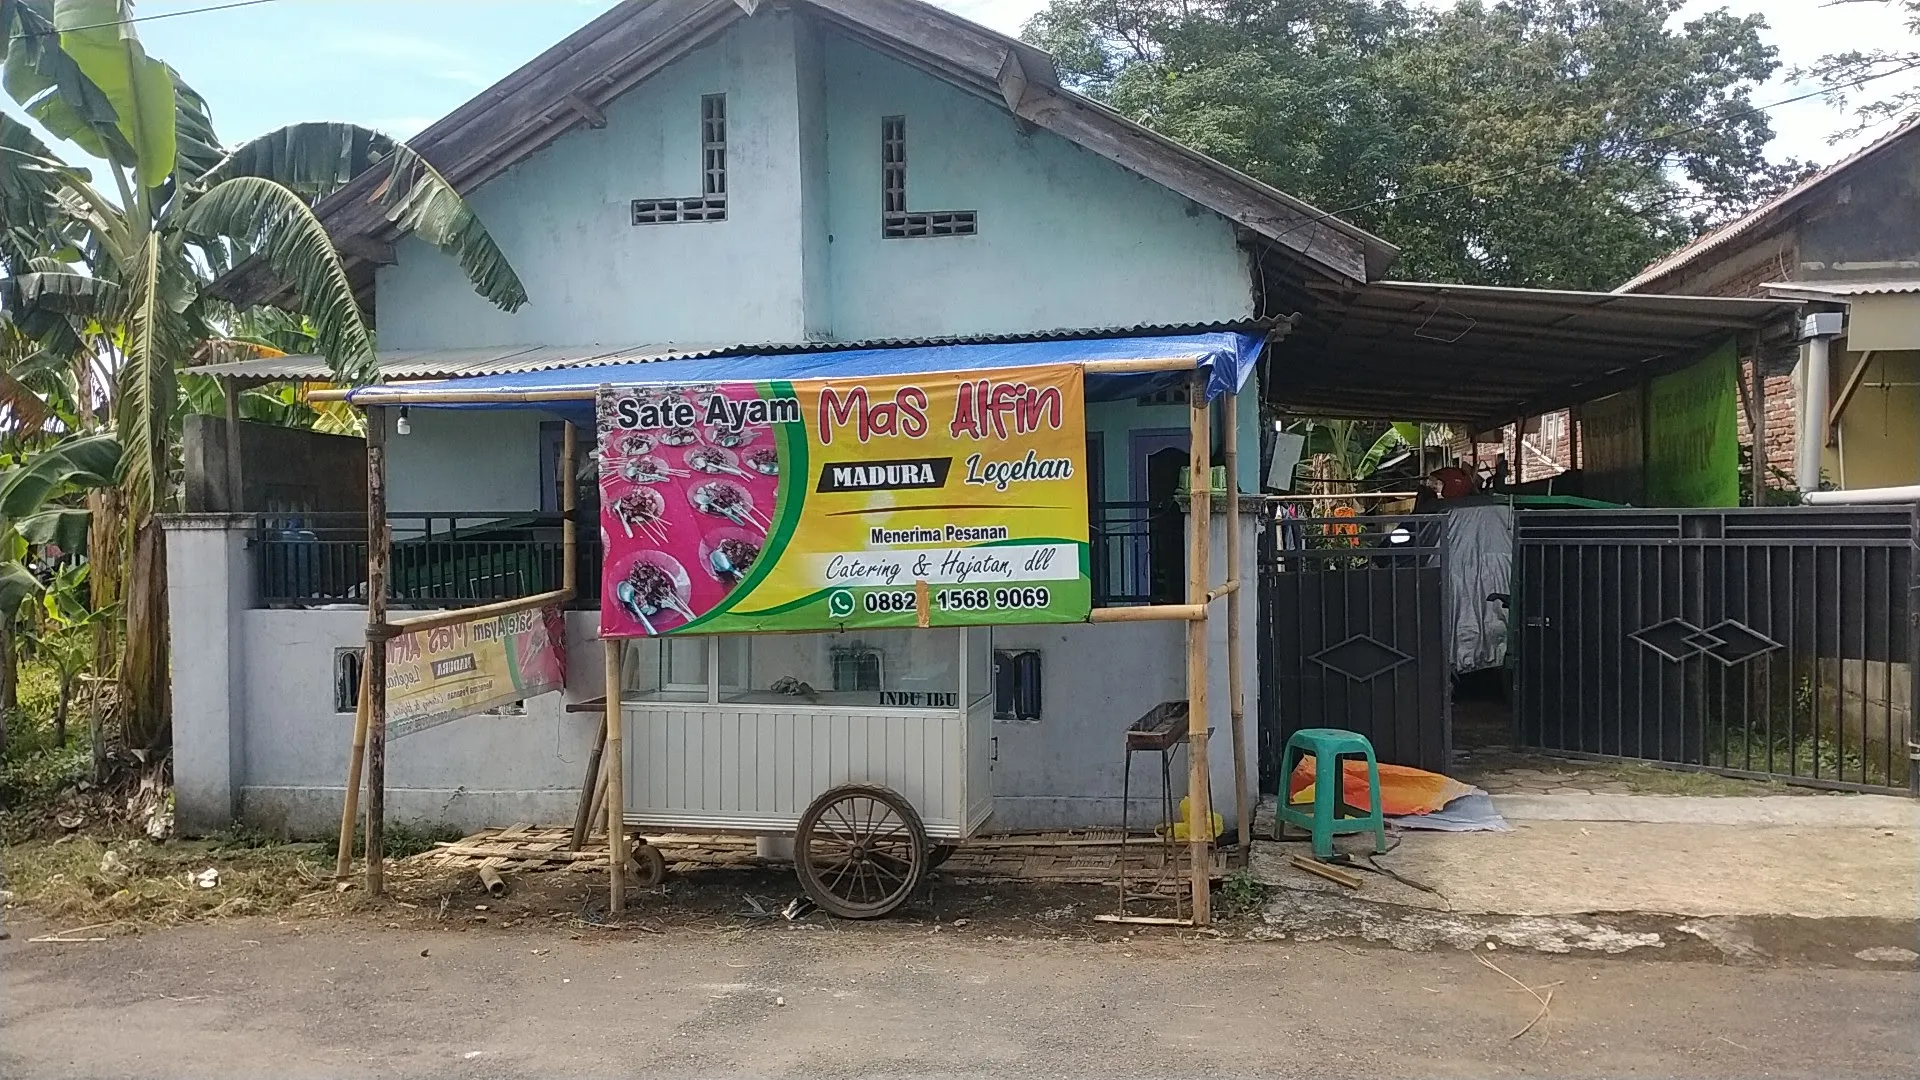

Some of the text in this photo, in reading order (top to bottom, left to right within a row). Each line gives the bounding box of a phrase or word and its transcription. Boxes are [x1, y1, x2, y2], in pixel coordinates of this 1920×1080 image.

[617, 394, 801, 435] Sate Ayam
[832, 462, 936, 487] MADURA
[871, 525, 1007, 544] Menerima Pesanan
[826, 548, 1056, 585] Catering & Hajatan, dll
[936, 588, 989, 610] 1568
[995, 587, 1049, 609] 9069
[879, 691, 957, 707] INDU IBU
